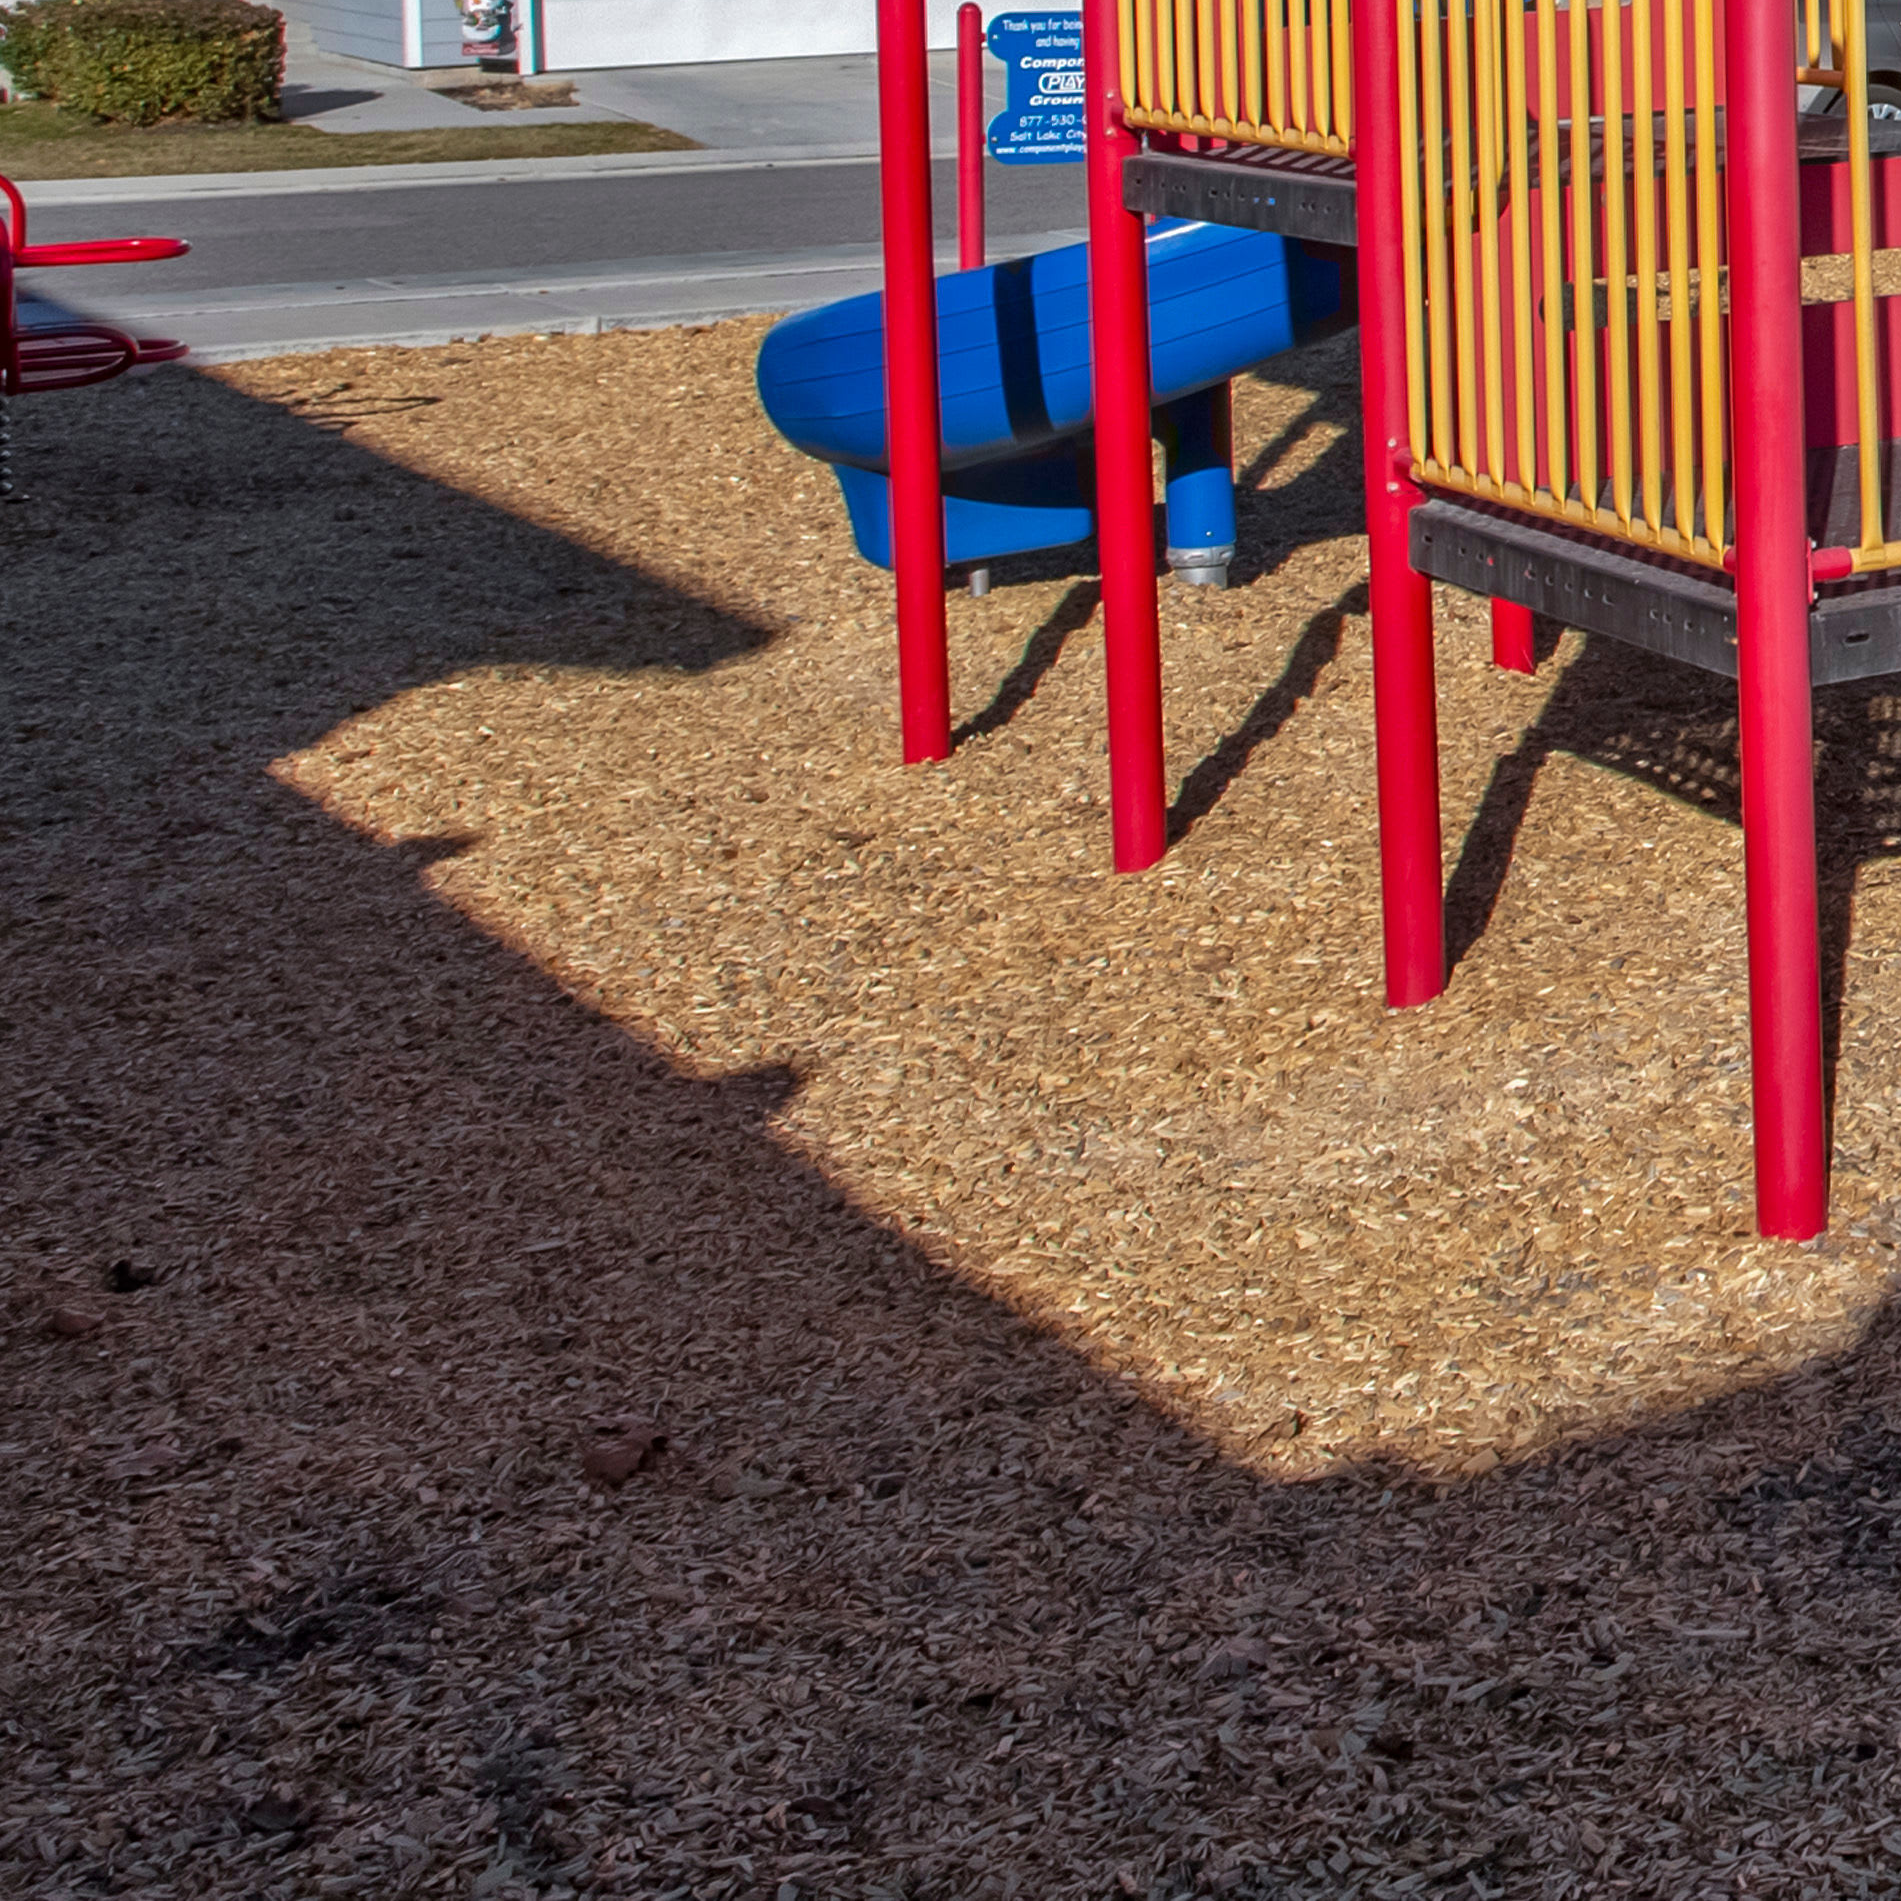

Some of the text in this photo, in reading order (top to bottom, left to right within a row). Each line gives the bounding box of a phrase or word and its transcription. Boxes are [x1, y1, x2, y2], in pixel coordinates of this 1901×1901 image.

[1002, 18, 1028, 31] Thank
[1030, 21, 1046, 34] you
[1048, 17, 1061, 30] for
[1036, 34, 1051, 47] and
[1010, 130, 1031, 142] Salt
[1036, 129, 1061, 141] Lake
